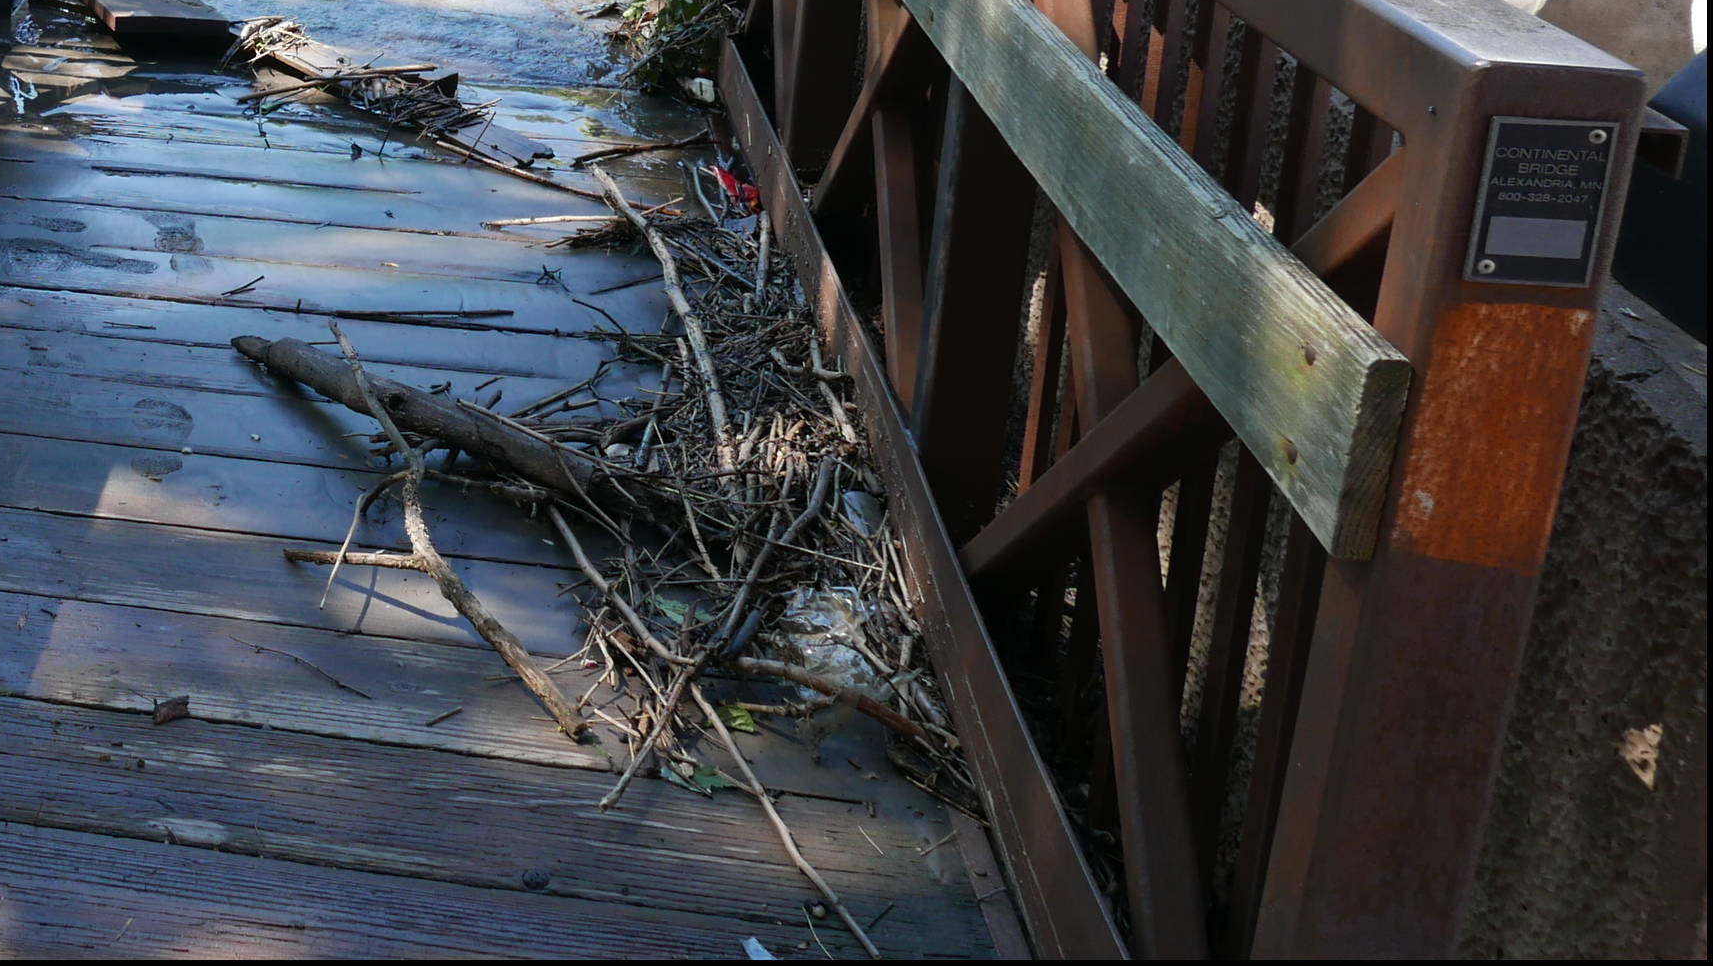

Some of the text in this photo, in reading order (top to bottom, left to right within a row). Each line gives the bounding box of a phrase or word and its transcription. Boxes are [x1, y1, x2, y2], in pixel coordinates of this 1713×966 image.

[1496, 147, 1607, 162] CONTINENTAL
[1518, 162, 1579, 175] BRIDGE
[1490, 177, 1603, 190] ALEXANDRIA, MN
